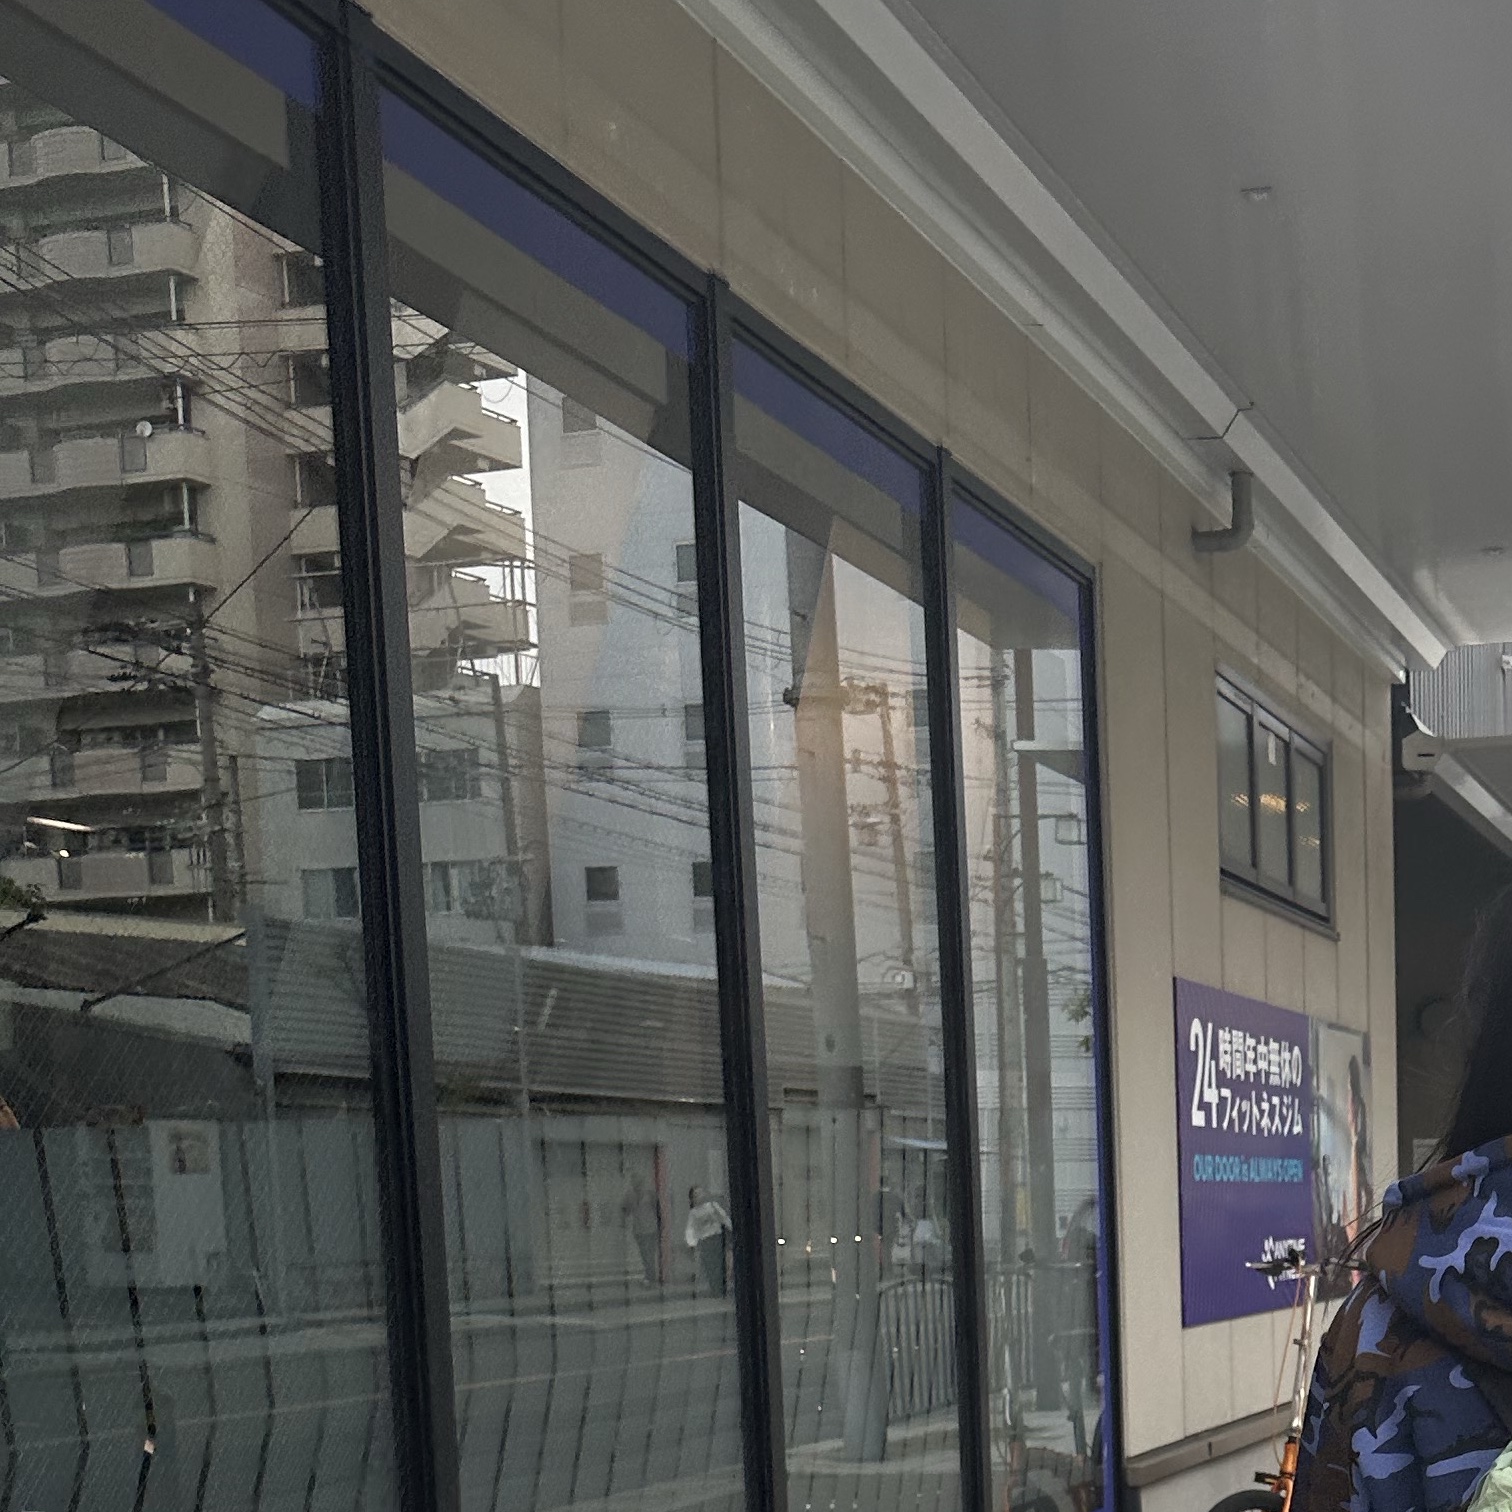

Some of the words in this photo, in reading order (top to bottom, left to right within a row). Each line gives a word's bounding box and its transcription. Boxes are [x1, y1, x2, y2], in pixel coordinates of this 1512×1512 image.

[1220, 1087, 1303, 1138] フィットネスジム
[1193, 1154, 1214, 1183] OUR
[1215, 1154, 1241, 1183] DOOR
